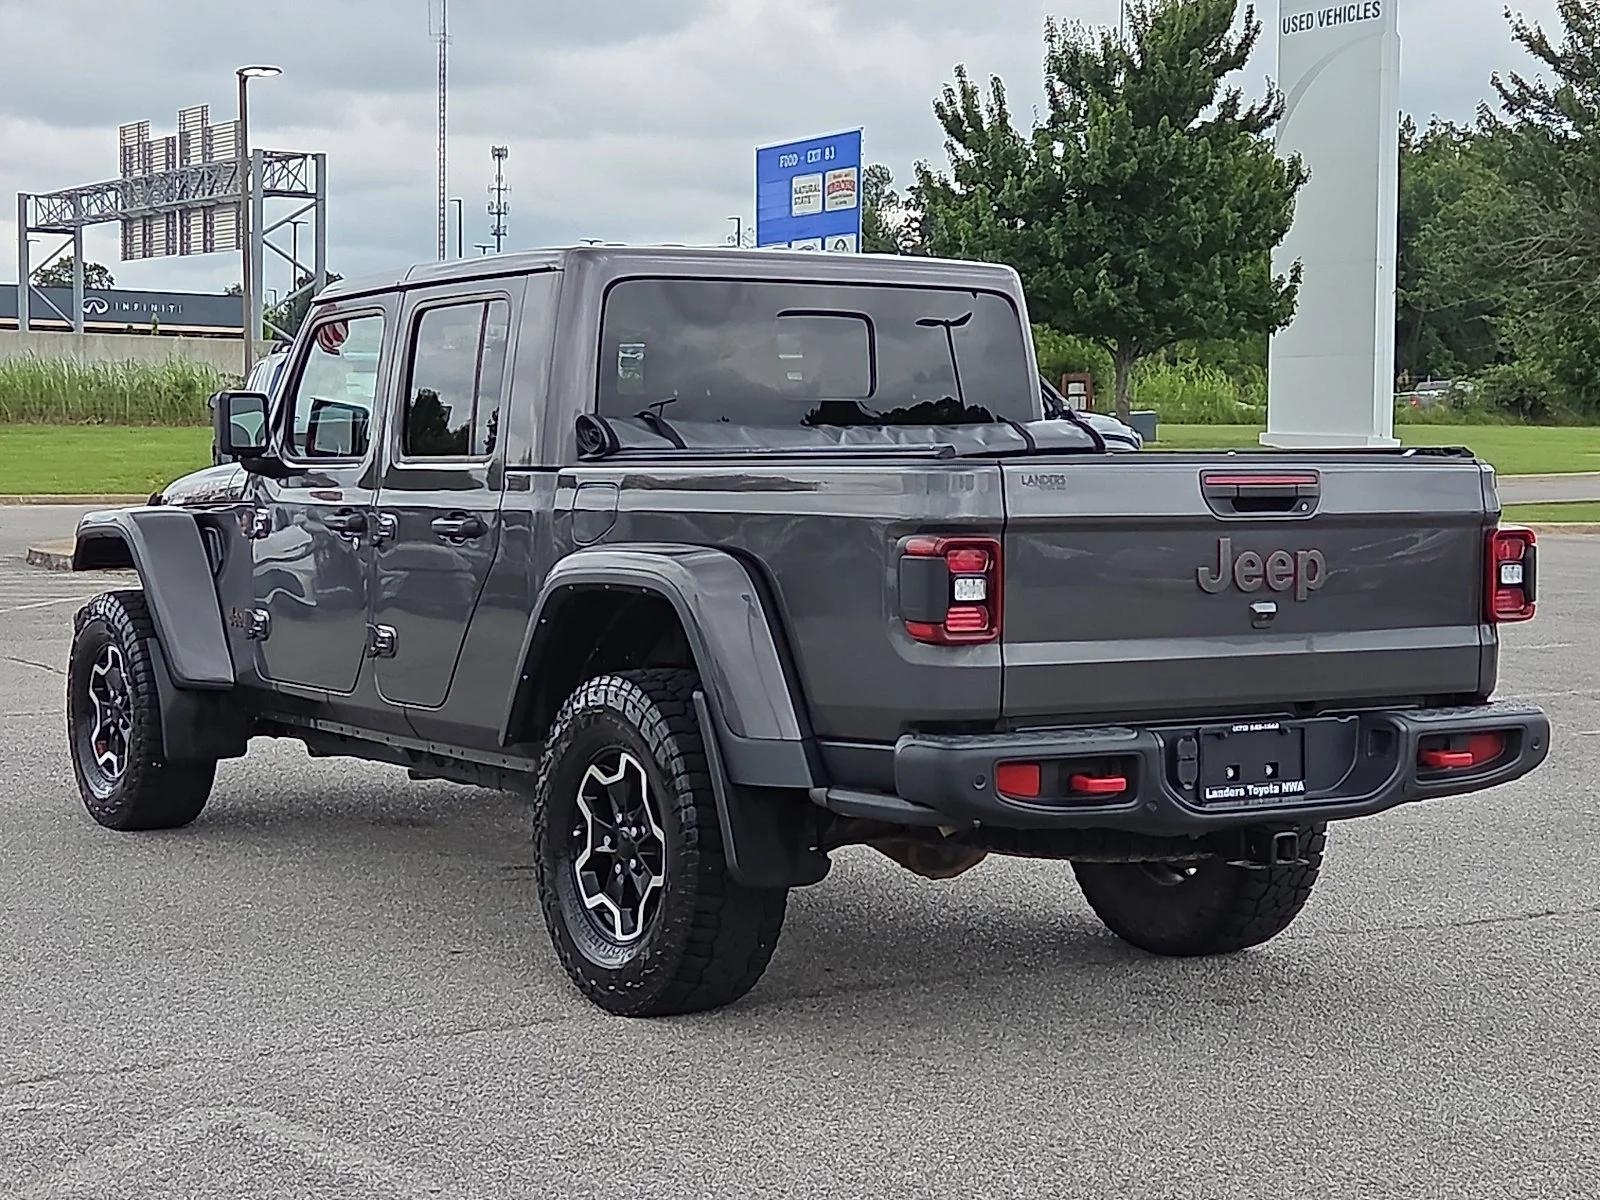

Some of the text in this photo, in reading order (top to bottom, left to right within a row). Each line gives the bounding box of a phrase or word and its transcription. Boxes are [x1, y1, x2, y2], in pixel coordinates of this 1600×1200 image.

[1282, 1, 1381, 34] USED VEHICLES
[779, 152, 798, 168] FOOD
[794, 183, 821, 195] NATURAL
[794, 195, 812, 206] STATE
[114, 301, 183, 314] INFINITI
[1021, 474, 1066, 487] LANDERS
[1197, 537, 1327, 602] Jeep
[1205, 780, 1305, 799] Landers Toyota NWA
